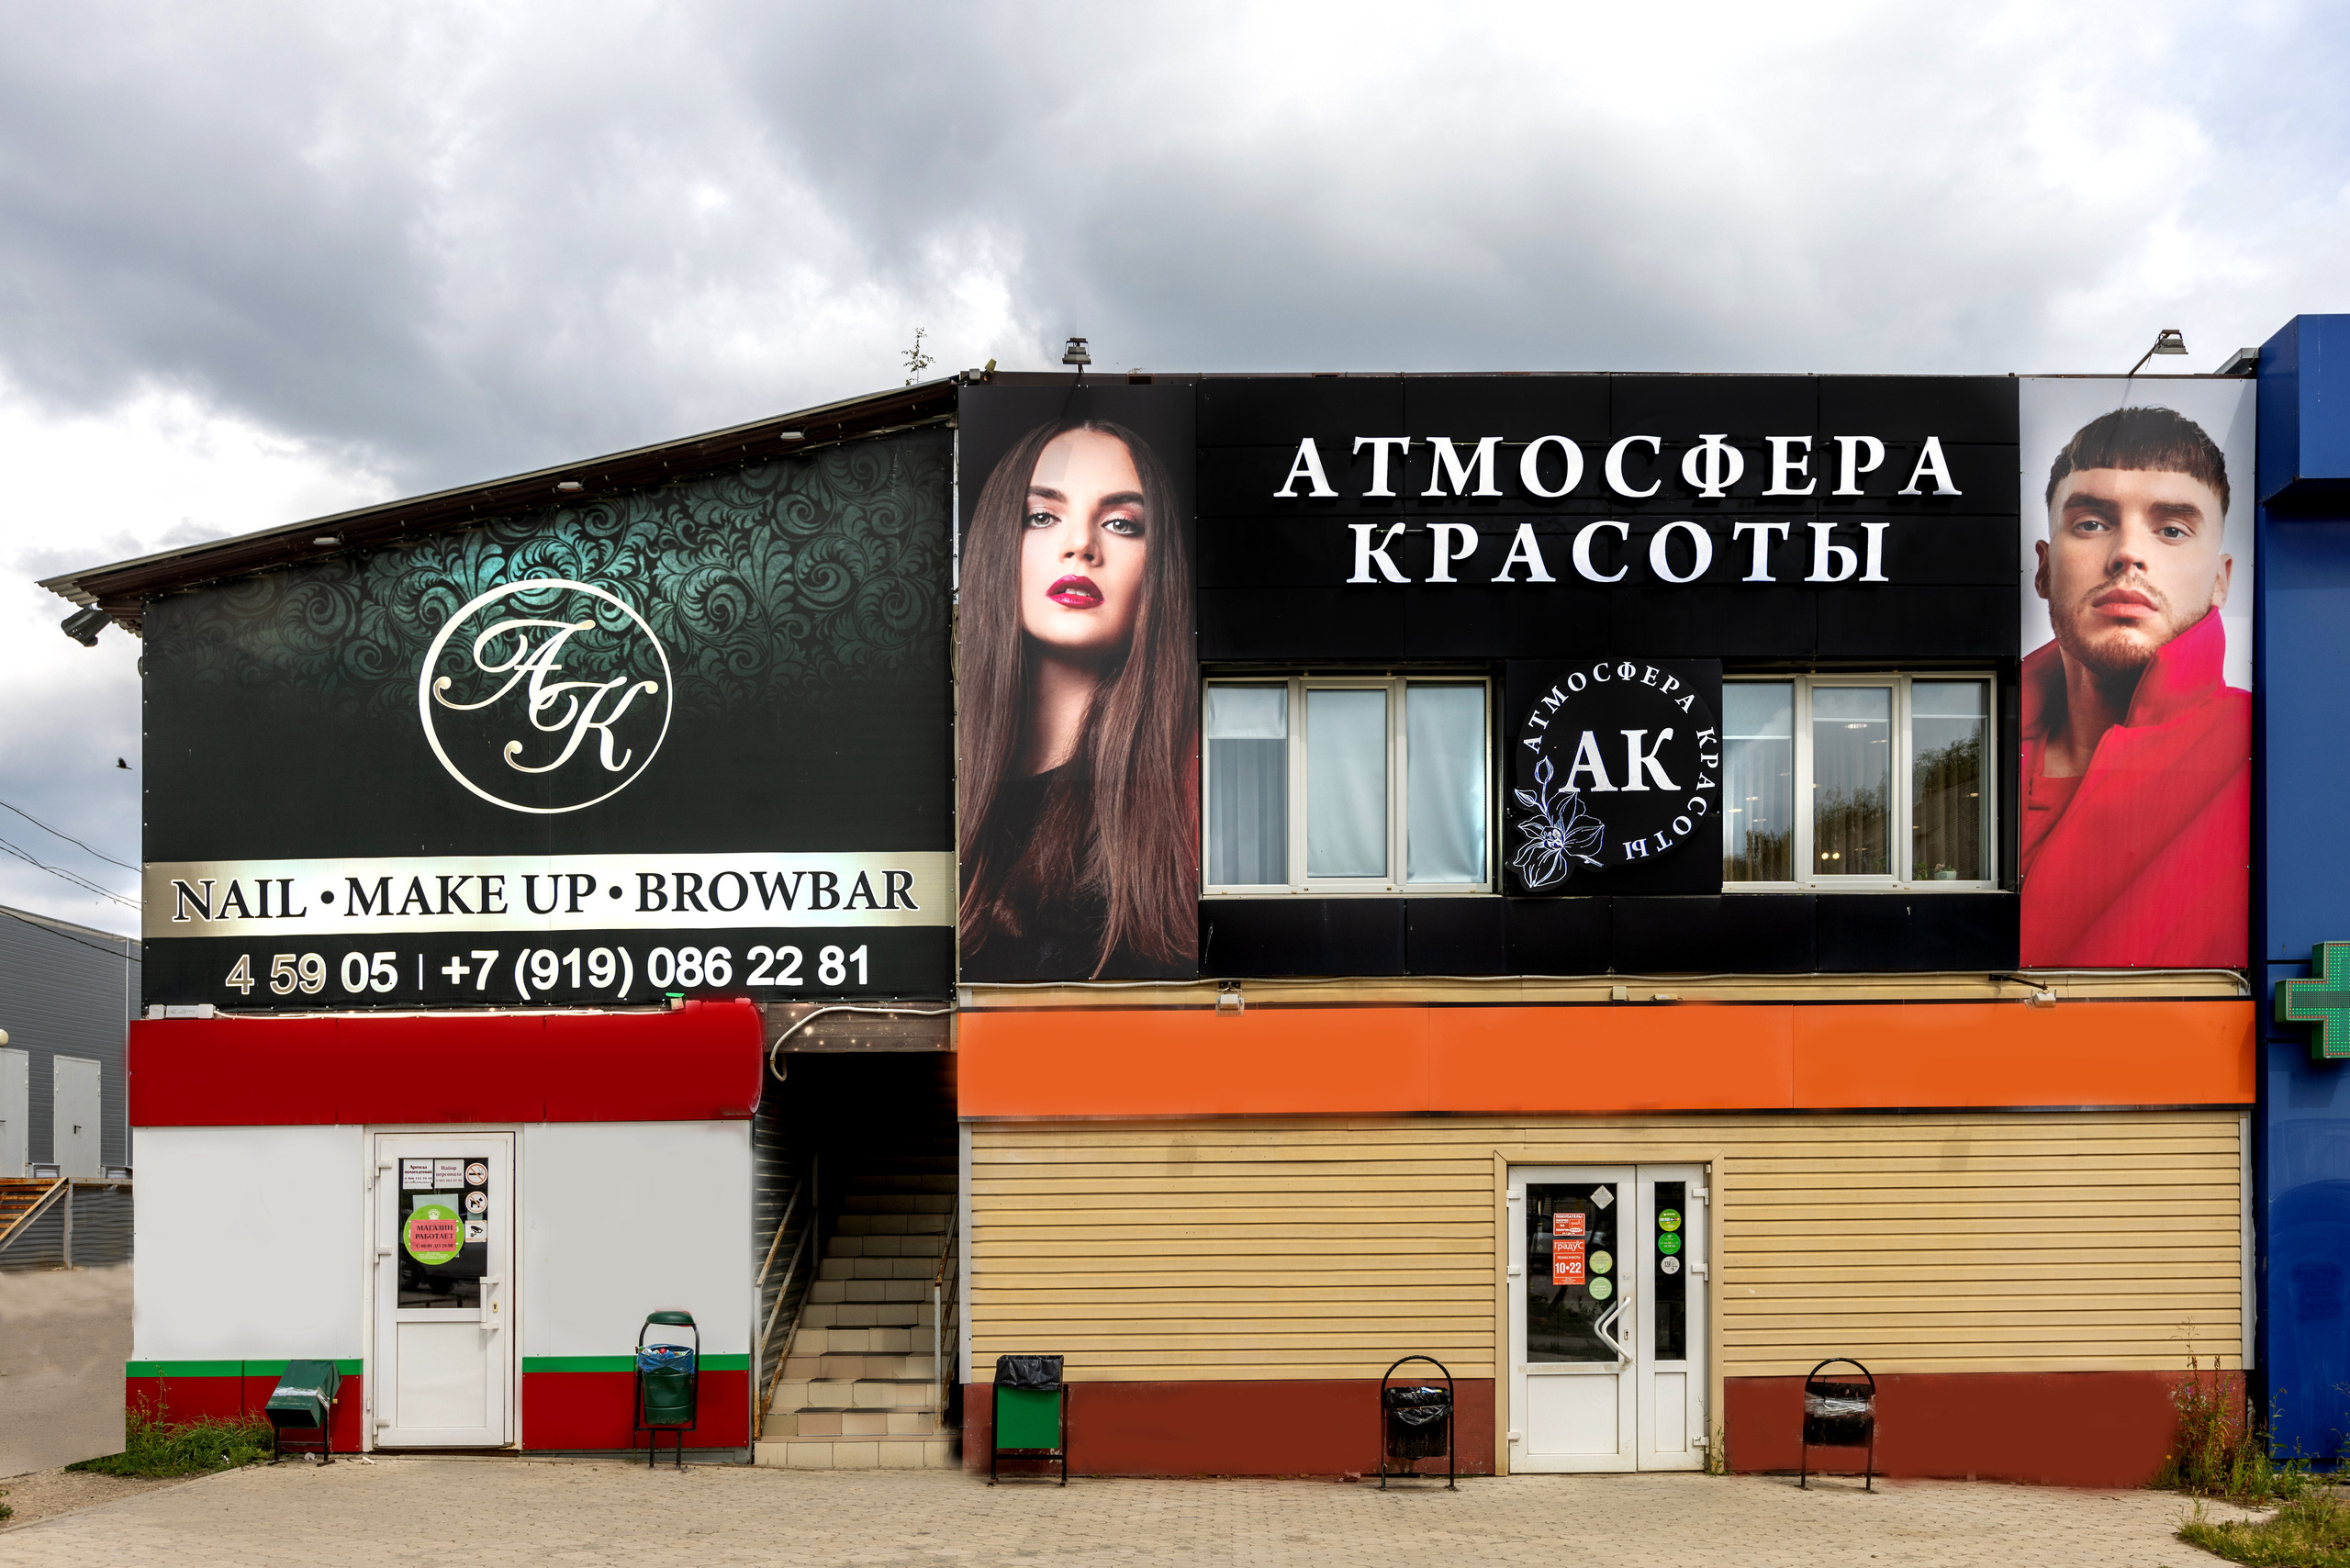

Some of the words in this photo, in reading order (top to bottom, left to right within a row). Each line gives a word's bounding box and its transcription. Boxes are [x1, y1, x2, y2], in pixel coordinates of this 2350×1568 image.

[1273, 433, 1963, 498] АТМОСФЕРА
[1346, 521, 1891, 584] КРАСОТЫ
[1523, 661, 1695, 755] АТМОСФЕРА
[1622, 726, 1719, 861] КРАСОТЫ
[172, 878, 308, 922] NAIL
[343, 874, 509, 917] MAKE
[520, 873, 597, 915] UP
[634, 869, 919, 913] BROWBAR
[225, 954, 255, 995] 4
[269, 952, 327, 994] 59
[341, 951, 398, 993] 05
[441, 949, 499, 991] +7
[514, 946, 634, 1000] (919)
[647, 946, 733, 988] 086
[745, 945, 804, 987] 22
[817, 944, 868, 986] 81
